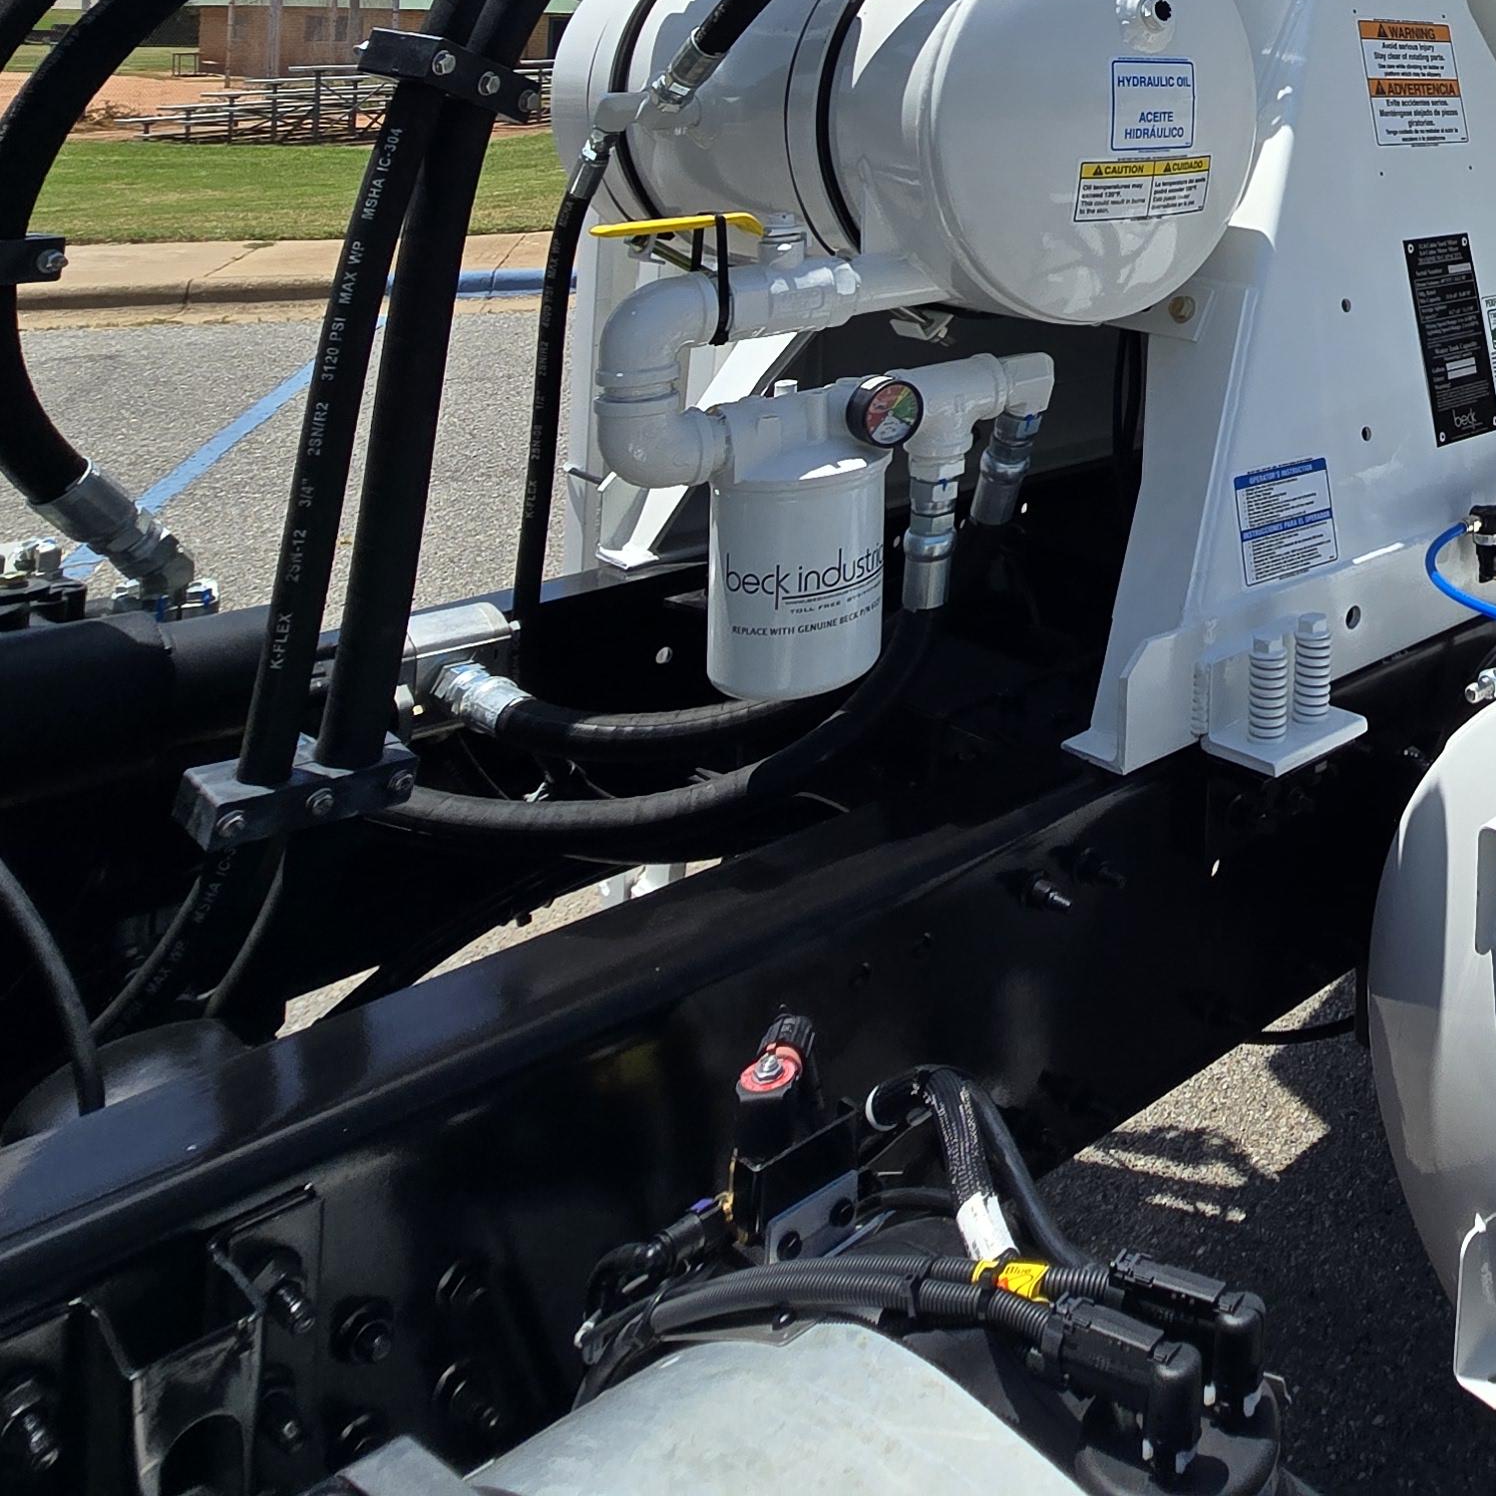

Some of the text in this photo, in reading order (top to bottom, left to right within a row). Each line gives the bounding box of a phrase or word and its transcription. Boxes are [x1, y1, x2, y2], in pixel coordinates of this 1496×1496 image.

[1389, 26, 1436, 39] WARNING
[1382, 42, 1397, 50] Avoid
[1374, 52, 1386, 61] Stay
[1117, 76, 1191, 87] HYDRAULIC OIL
[1388, 83, 1456, 95] ADVERTENCIA
[1139, 111, 1173, 123] ACEITE
[1124, 125, 1184, 140] HIDRÁULICO
[1104, 165, 1144, 175] CAUTION
[1172, 161, 1203, 171] CUIDADO
[269, 127, 403, 670] K-FLEX 2SN-12 3/4" 2SN/R2 3120 PSI MAX WP MSHA IC-304
[1452, 409, 1478, 430] beck
[525, 479, 538, 518] K-FLEX
[726, 552, 791, 610] beck
[818, 601, 841, 610] FREE
[732, 626, 768, 636] REPLACE
[770, 626, 795, 635] WITH
[798, 618, 837, 633] GENUINE
[839, 610, 859, 624] BECK
[194, 882, 222, 924] MSHA
